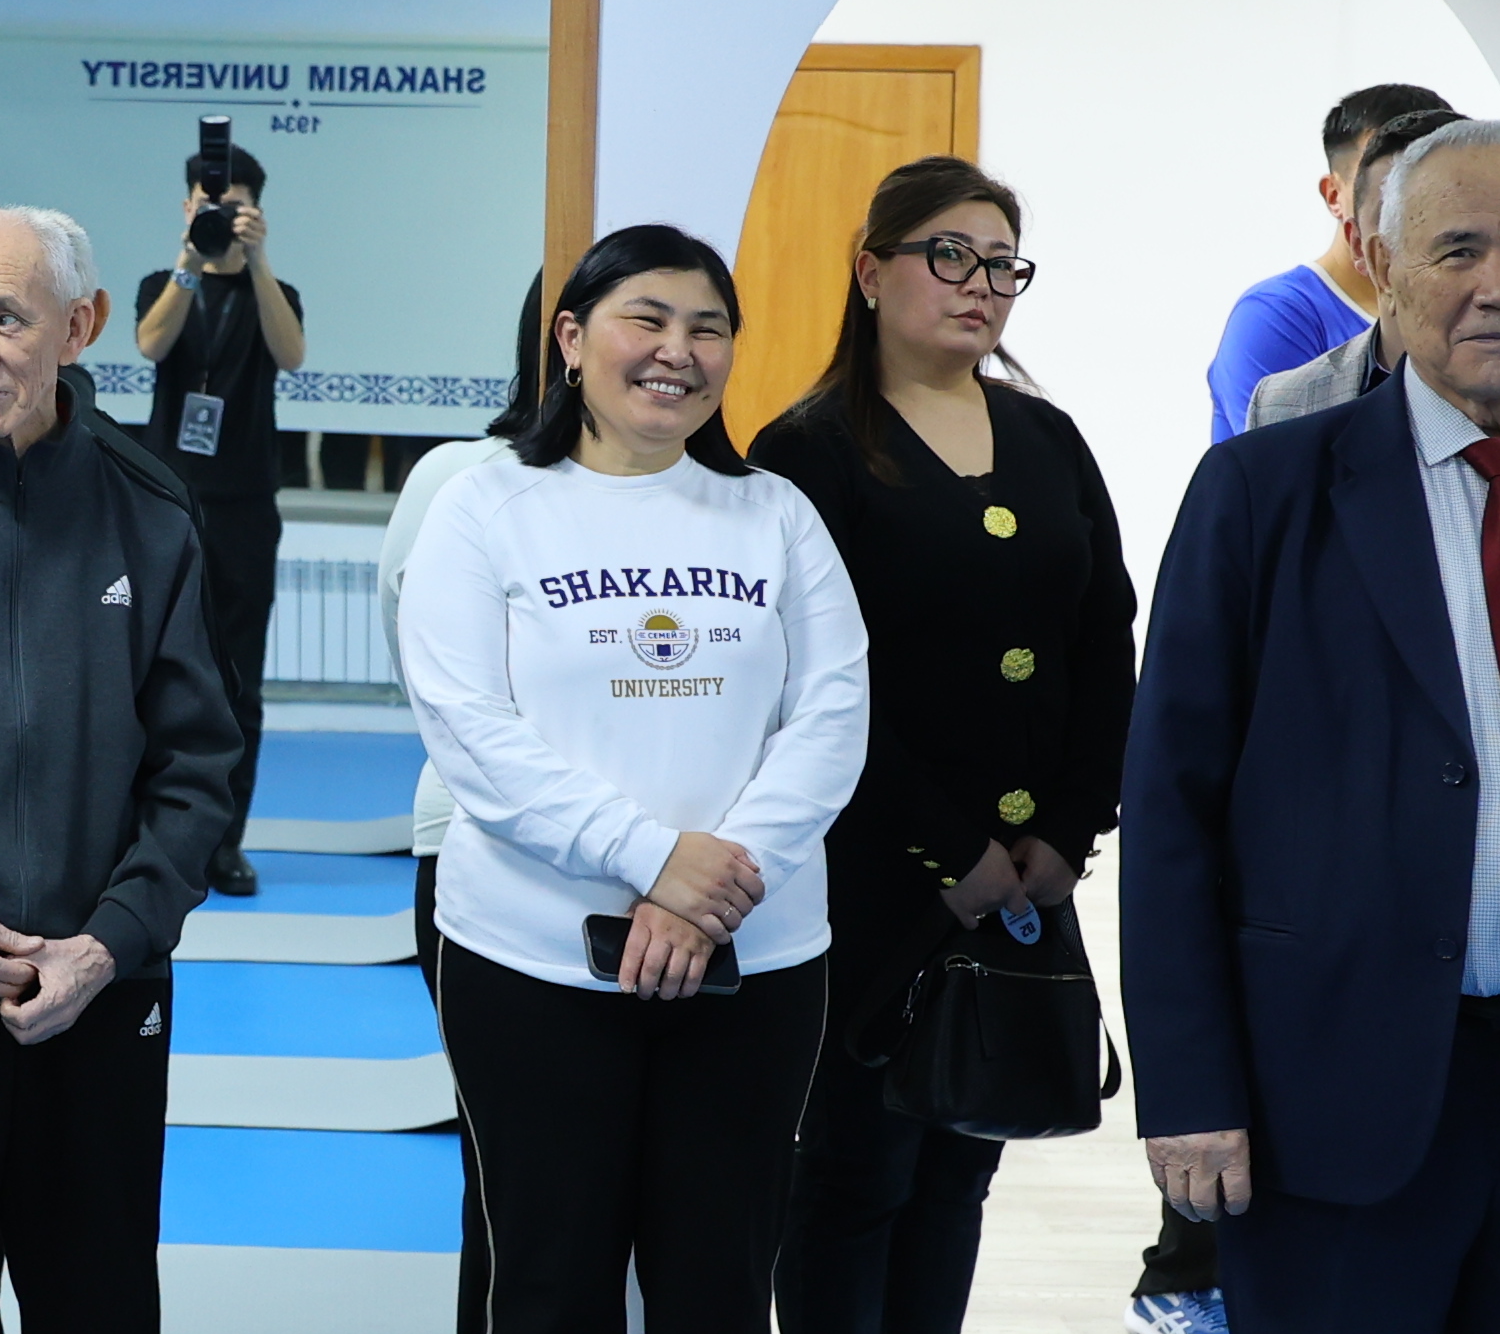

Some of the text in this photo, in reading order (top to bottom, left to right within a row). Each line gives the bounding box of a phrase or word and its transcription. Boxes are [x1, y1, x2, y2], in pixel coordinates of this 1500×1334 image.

[539, 567, 768, 609] SHAKARIM
[589, 628, 742, 644] EST. 1934
[647, 630, 677, 640] СЕМЕЙ
[610, 677, 725, 698] UNIVERSITY
